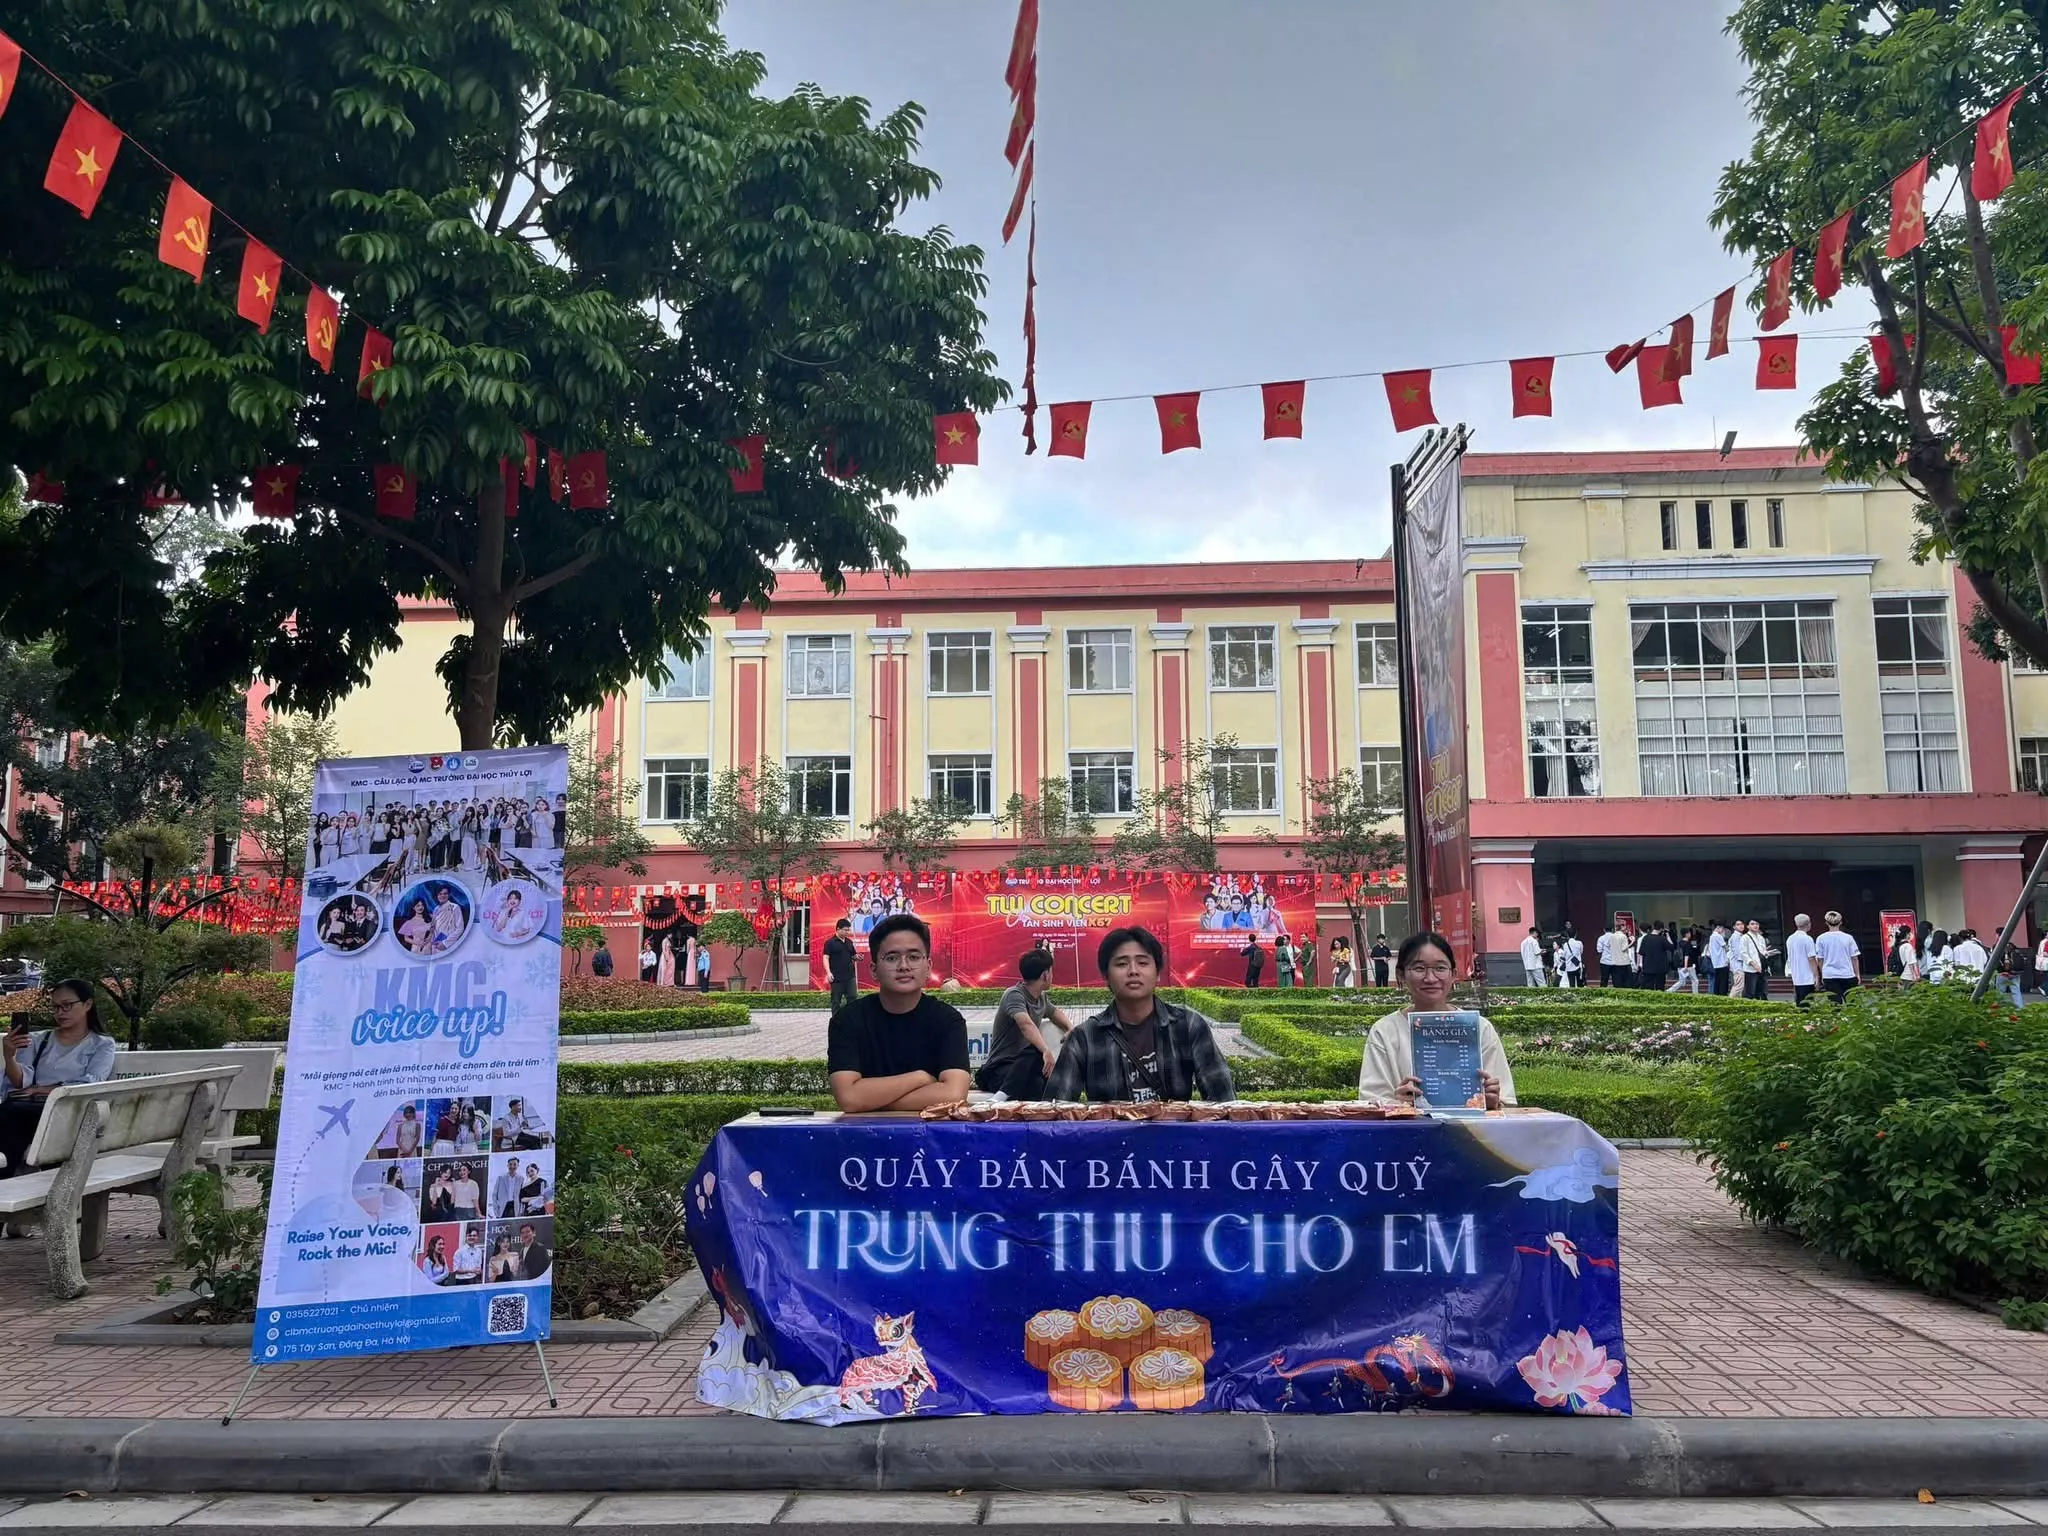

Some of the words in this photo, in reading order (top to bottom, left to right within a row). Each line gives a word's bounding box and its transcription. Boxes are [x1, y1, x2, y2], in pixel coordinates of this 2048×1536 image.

[374, 777, 390, 786] CÂU
[391, 778, 406, 786] LẠC
[433, 773, 464, 782] TRƯỜNG
[481, 772, 497, 780] HỌC
[986, 894, 1025, 915] TLU
[1030, 894, 1132, 918] CONCERT
[1042, 919, 1064, 927] SINH
[1067, 918, 1087, 927] VIÊN
[1088, 918, 1112, 928] K67
[374, 961, 487, 1015] KMC
[352, 1004, 438, 1044] voice
[444, 992, 506, 1056] up!
[323, 1070, 348, 1081] giọng
[349, 1068, 363, 1077] nói
[402, 1064, 420, 1072] một
[435, 1062, 449, 1071] hội
[353, 1080, 375, 1088] Hành
[840, 1148, 960, 1190] QUẦY
[978, 1152, 1066, 1190] BÁN
[1087, 1152, 1210, 1190] BÁNH
[1231, 1154, 1320, 1191] GÂY
[1339, 1154, 1432, 1194] QUỸ
[287, 1230, 324, 1244] Raise
[328, 1226, 364, 1240] Your
[368, 1223, 412, 1237] Voice,
[795, 1208, 1008, 1272] TRUNG
[1038, 1212, 1174, 1272] THU
[1204, 1214, 1354, 1274] CHO
[1384, 1214, 1478, 1275] EM
[298, 1244, 332, 1261] Rock
[336, 1244, 361, 1258] the
[364, 1241, 397, 1256] Mic!
[350, 1304, 369, 1314] Chủ
[371, 1302, 399, 1312] nhiệm
[283, 1345, 297, 1353] 175
[299, 1342, 316, 1354] Tây
[339, 1337, 362, 1350] Đống
[381, 1336, 394, 1345] Hà
[397, 1335, 410, 1345] Nội
